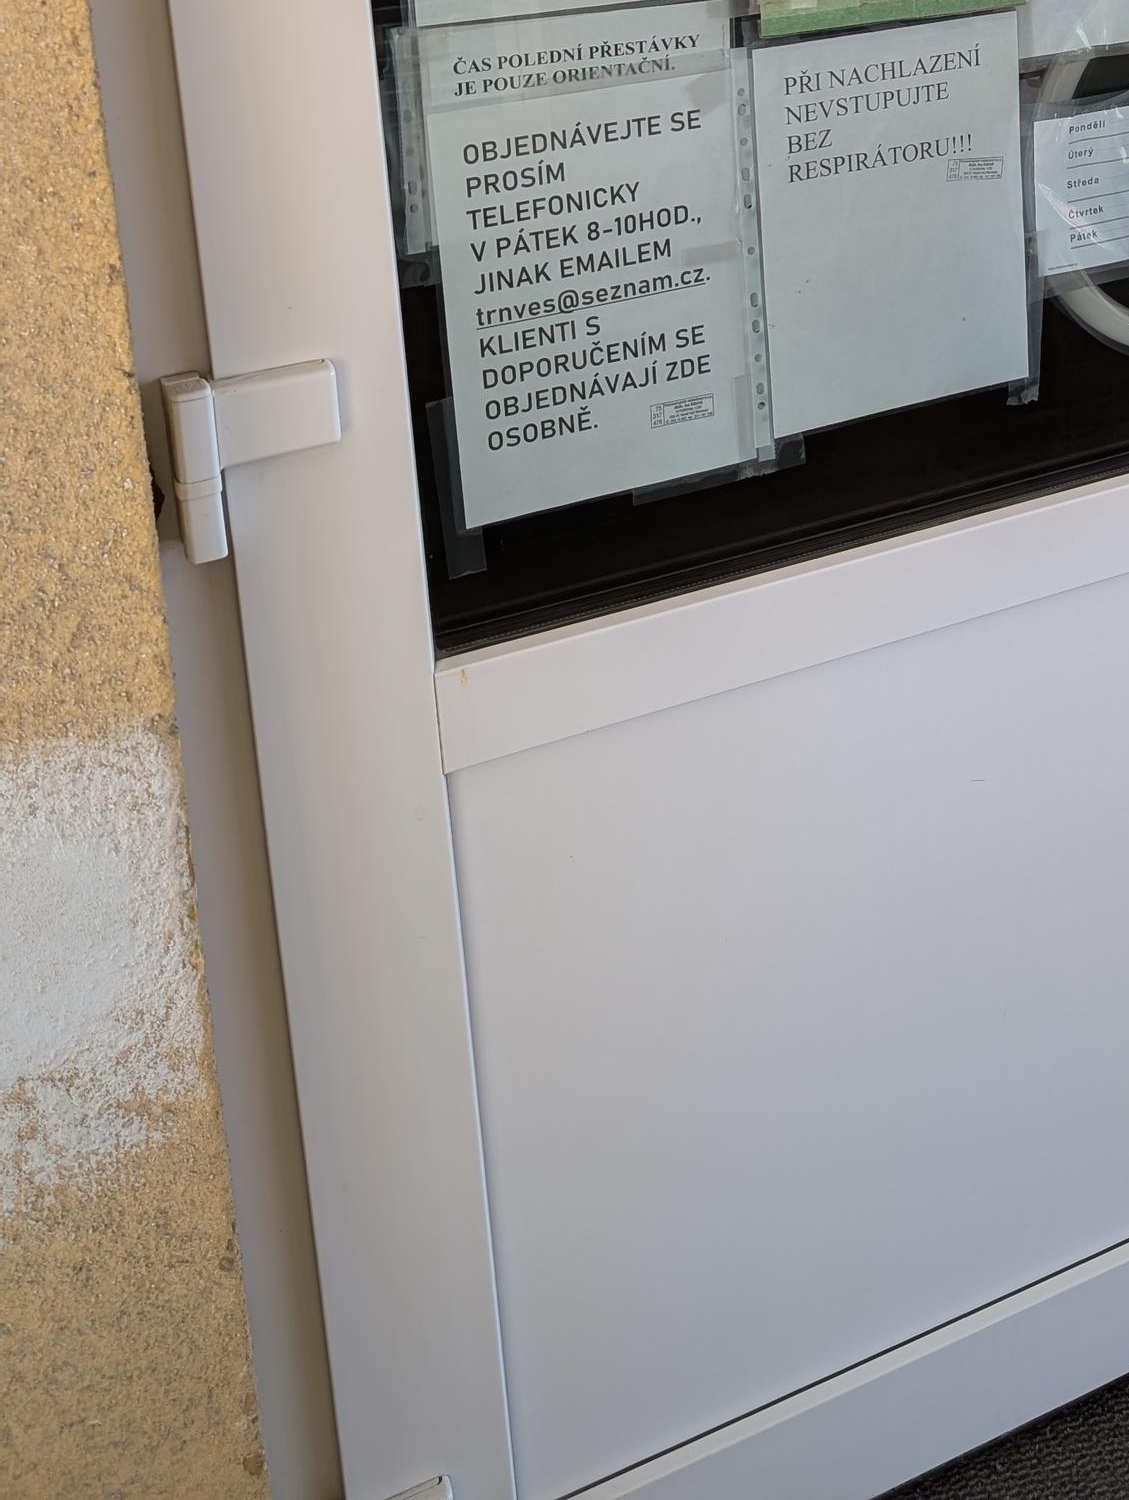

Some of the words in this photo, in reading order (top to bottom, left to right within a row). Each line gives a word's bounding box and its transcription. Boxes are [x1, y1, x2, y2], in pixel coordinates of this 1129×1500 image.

[453, 57, 492, 75] ČAS
[498, 44, 584, 70] POLEDNÍ
[589, 34, 700, 60] PŘESTÁVKY
[454, 80, 477, 97] JE
[482, 72, 547, 94] POUZE
[552, 55, 676, 85] ORIENTAČNÍ.
[784, 70, 821, 96] PŘI
[828, 43, 981, 88] NACHLAZENÍ
[785, 82, 949, 125] NEVSTUPUJTE
[463, 115, 661, 165] OBJEDNÁVEJTE
[670, 109, 701, 132] SE
[787, 129, 833, 154] BEZ
[1069, 120, 1106, 134] Pondělí
[788, 134, 972, 183] RESPIRÁTORU!!!
[1068, 147, 1094, 160] Úterý
[466, 160, 566, 198] PROSÍM
[1067, 176, 1100, 189] Středa
[466, 182, 640, 231] TELEFONICKY
[1068, 205, 1104, 220] Čtvrtek
[470, 242, 486, 262] V
[497, 225, 579, 259] PÁTEK
[587, 204, 702, 241] 8-10HOD.,
[1070, 230, 1098, 243] Pátek
[474, 262, 551, 295] JINAK
[560, 238, 671, 279] EMAILEM
[476, 267, 711, 327] trnves@seznam.cz.
[480, 320, 576, 358] KLIENTI
[585, 315, 601, 336] S
[483, 329, 666, 390] DOPORUČENÍM
[675, 325, 705, 348] SE
[485, 361, 658, 420] OBJEDNÁVAJÍ
[666, 354, 711, 382] ZDE
[488, 406, 599, 451] OSOBNĚ.
